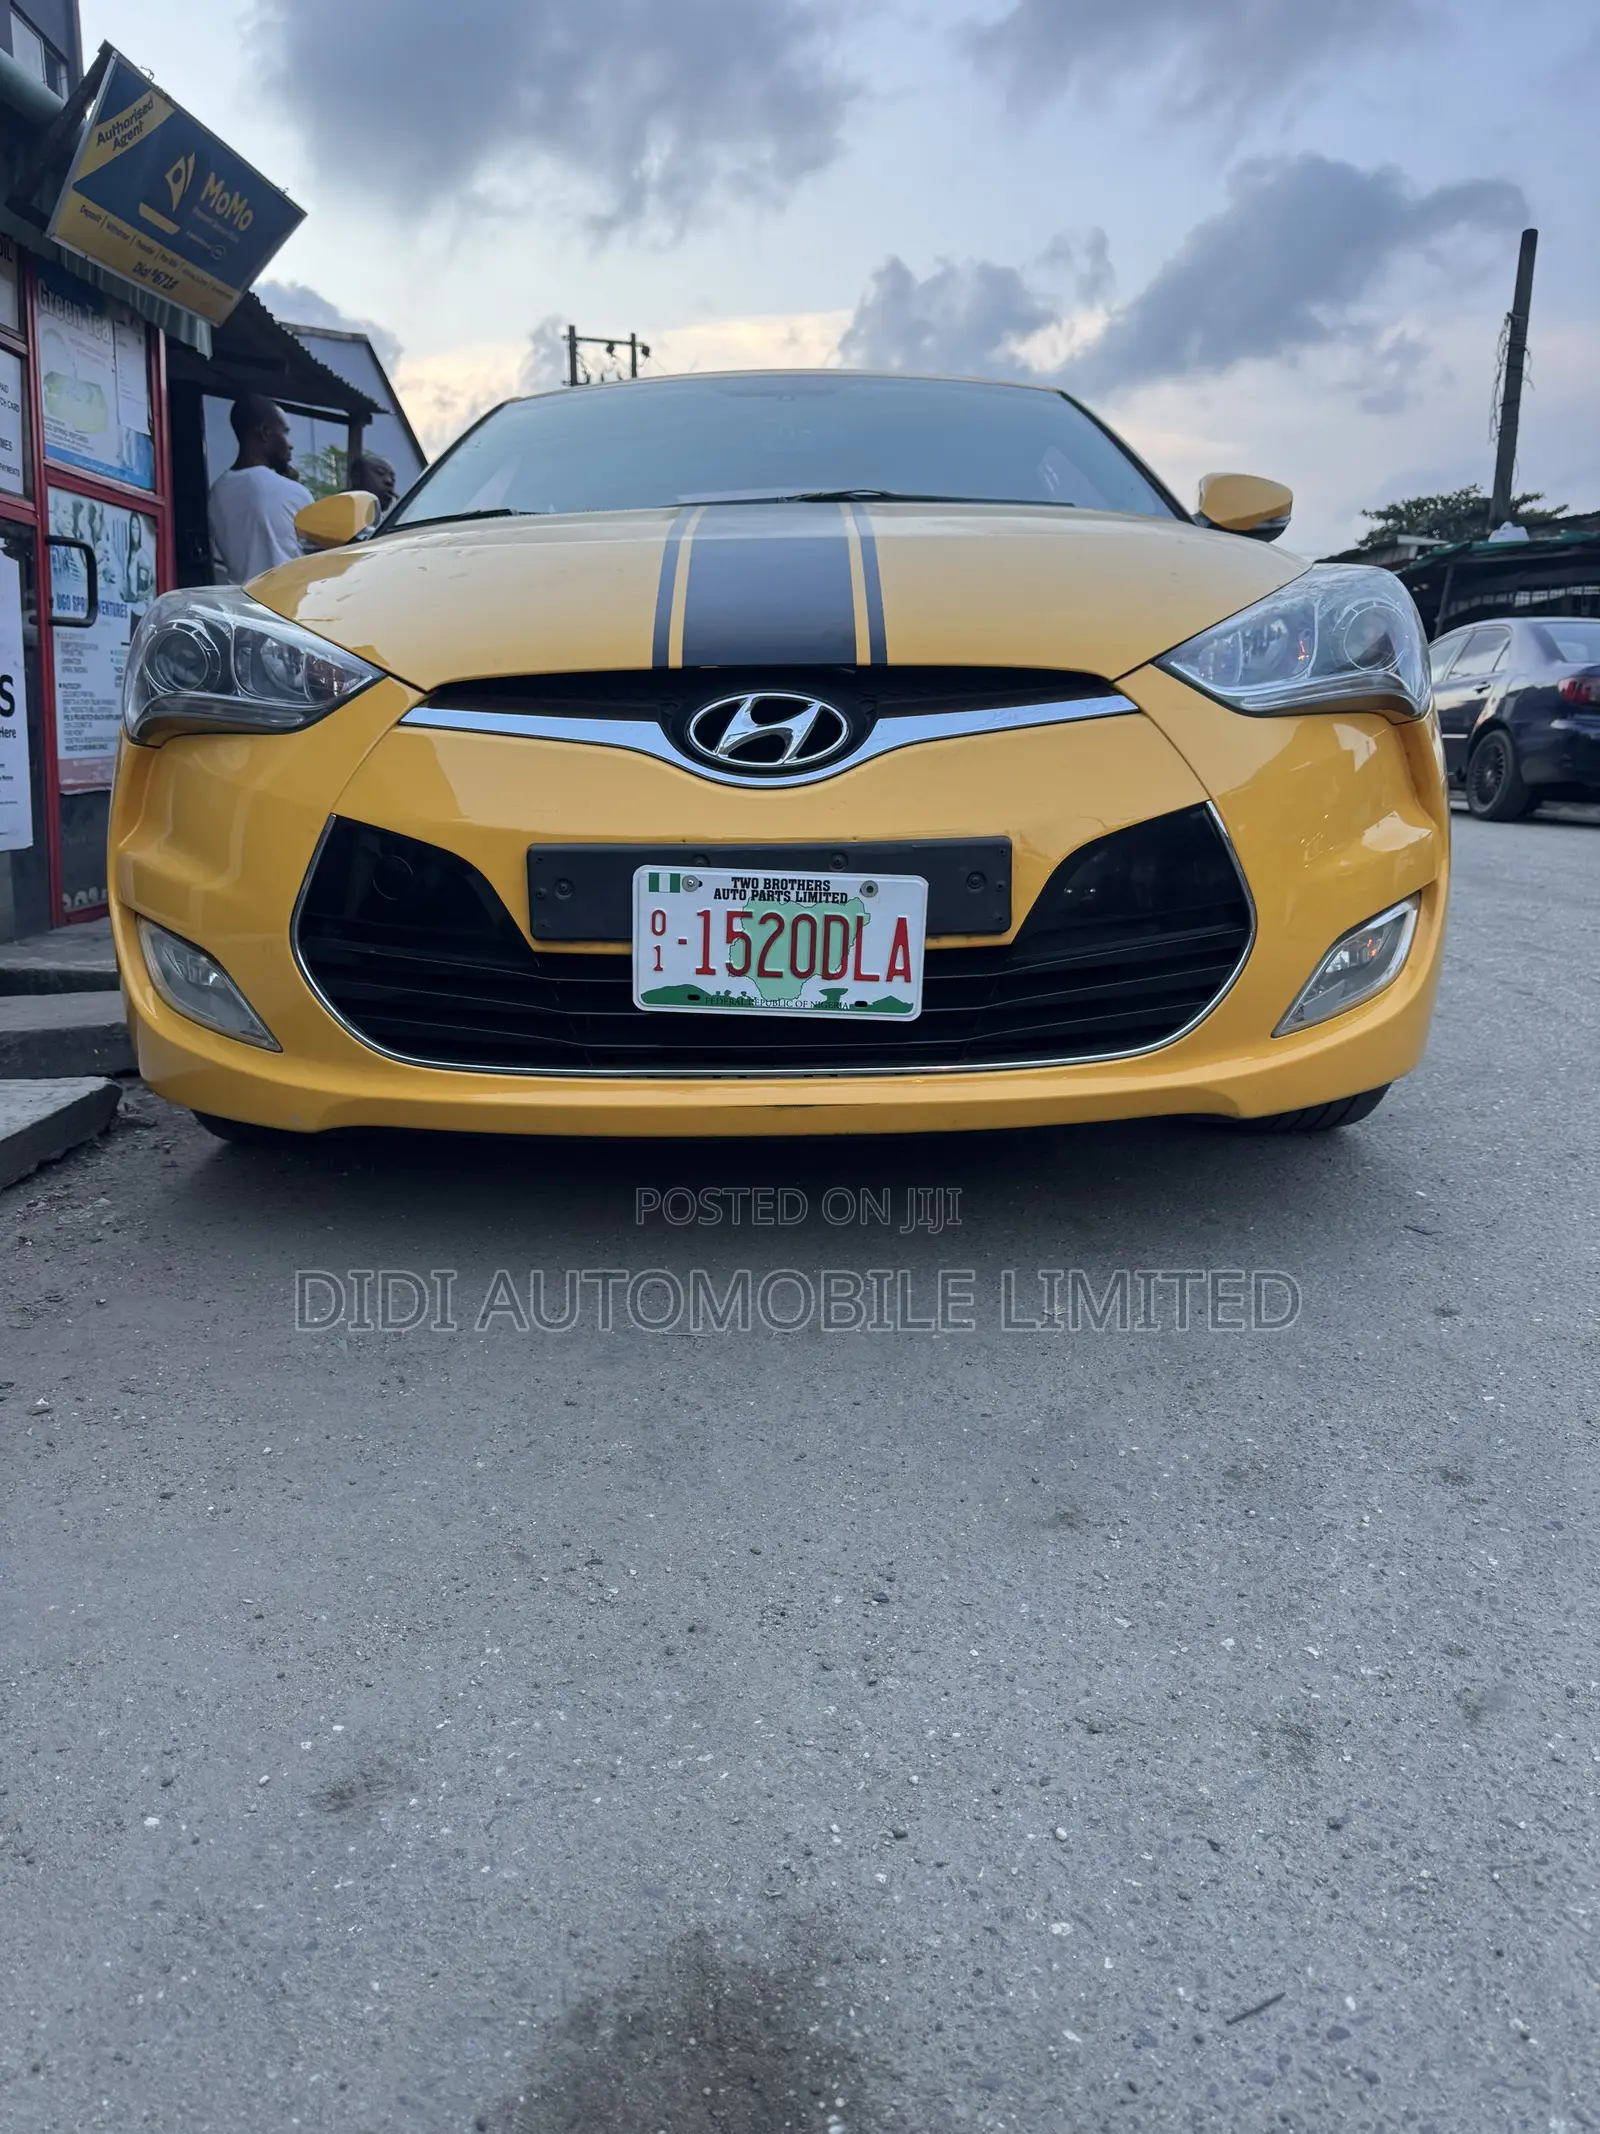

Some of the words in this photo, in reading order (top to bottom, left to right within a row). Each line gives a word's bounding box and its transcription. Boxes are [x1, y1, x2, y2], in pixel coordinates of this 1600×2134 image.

[97, 94, 154, 147] Authorised
[112, 121, 144, 151] Agent
[200, 171, 254, 231] MoMo
[37, 278, 83, 331] Green
[85, 301, 112, 346] Tea
[713, 888, 747, 901] AUTO
[751, 890, 791, 903] PARTS
[795, 891, 848, 905] LIMITED
[731, 877, 759, 890] TWO
[763, 878, 831, 892] BROTHERS
[705, 996, 745, 1006] FEDERAL
[750, 998, 793, 1008] REPUBLIC
[795, 1000, 808, 1008] OF
[810, 1000, 850, 1010] NIGERIA
